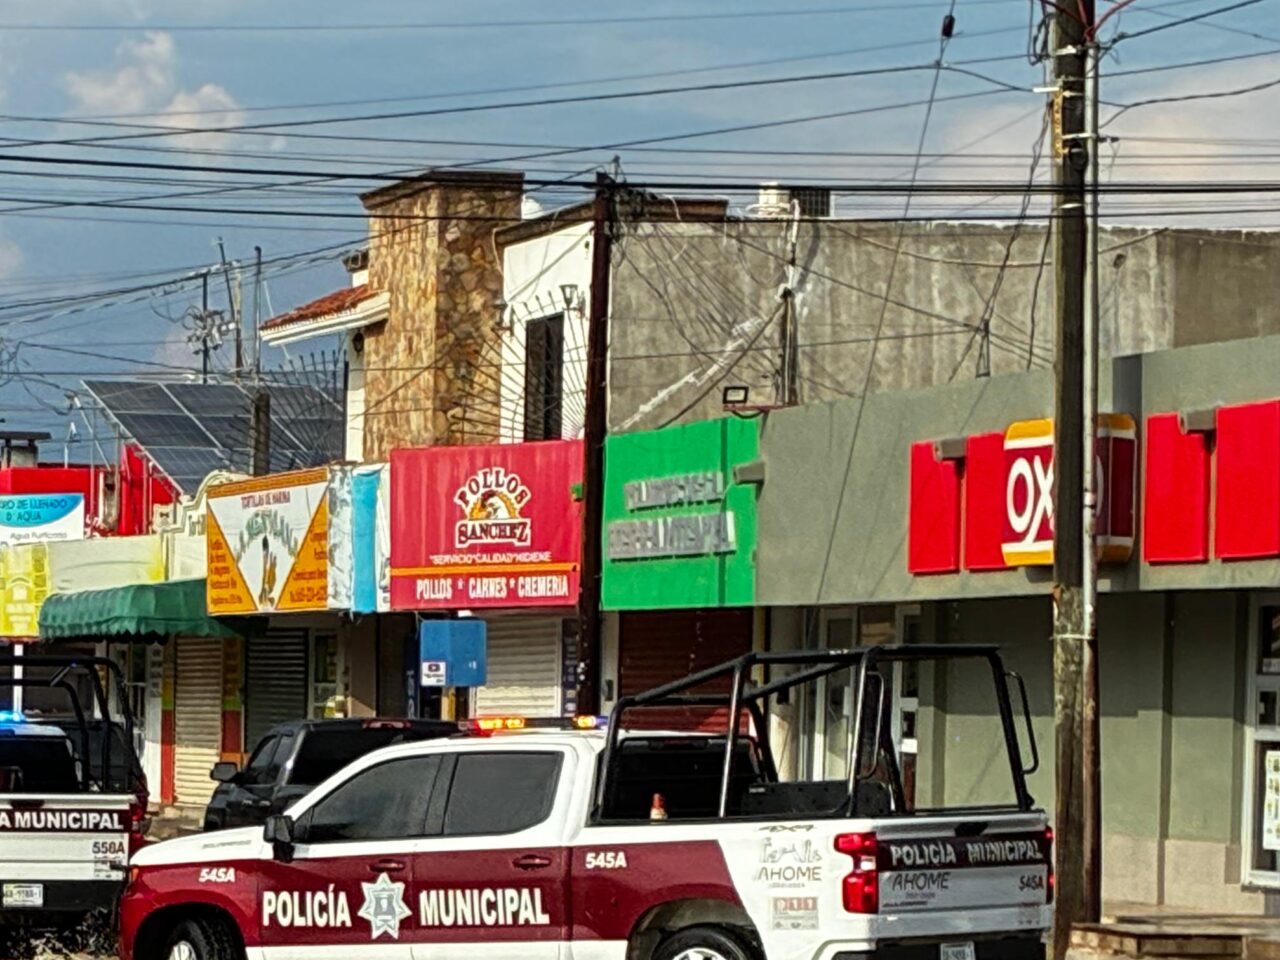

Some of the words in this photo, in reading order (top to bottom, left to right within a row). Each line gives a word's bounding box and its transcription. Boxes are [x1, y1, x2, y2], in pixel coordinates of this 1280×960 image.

[457, 470, 529, 507] POLLOS
[457, 521, 528, 545] SANCHEZ
[416, 578, 453, 599] POLLOS
[468, 577, 507, 599] CARNES
[14, 811, 124, 829] MUNICIPAL
[585, 852, 628, 869] 545A
[967, 839, 1043, 864] MUNICIPAL
[198, 867, 236, 883] 545A
[757, 866, 822, 881] AHOME
[891, 872, 951, 891] AHOME
[263, 884, 352, 928] POLICÍA
[420, 888, 550, 926] MUNICIPAL
